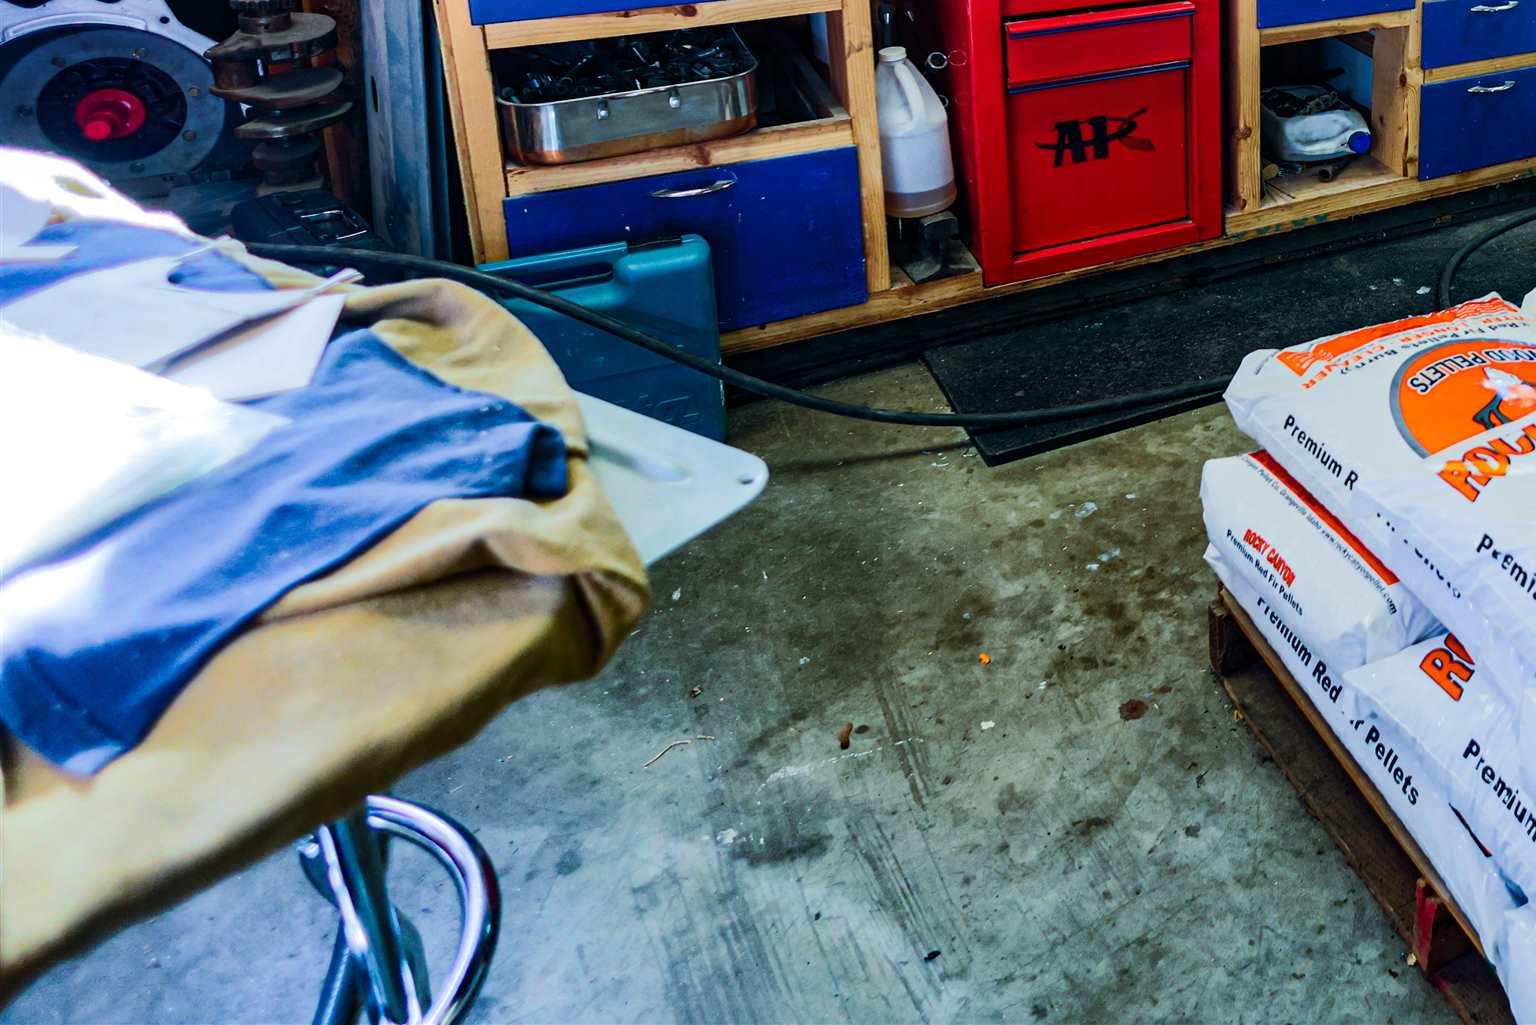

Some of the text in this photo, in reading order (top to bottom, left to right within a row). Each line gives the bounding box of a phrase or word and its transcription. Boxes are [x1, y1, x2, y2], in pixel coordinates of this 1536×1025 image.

[1407, 350, 1489, 394] PELLETS
[1283, 414, 1344, 479] Premium
[1225, 528, 1304, 617] Premium Red Fir Pellets
[1242, 527, 1297, 589] ROCKY CANYON
[1312, 659, 1343, 704] Red
[1365, 724, 1420, 807] Pellets
